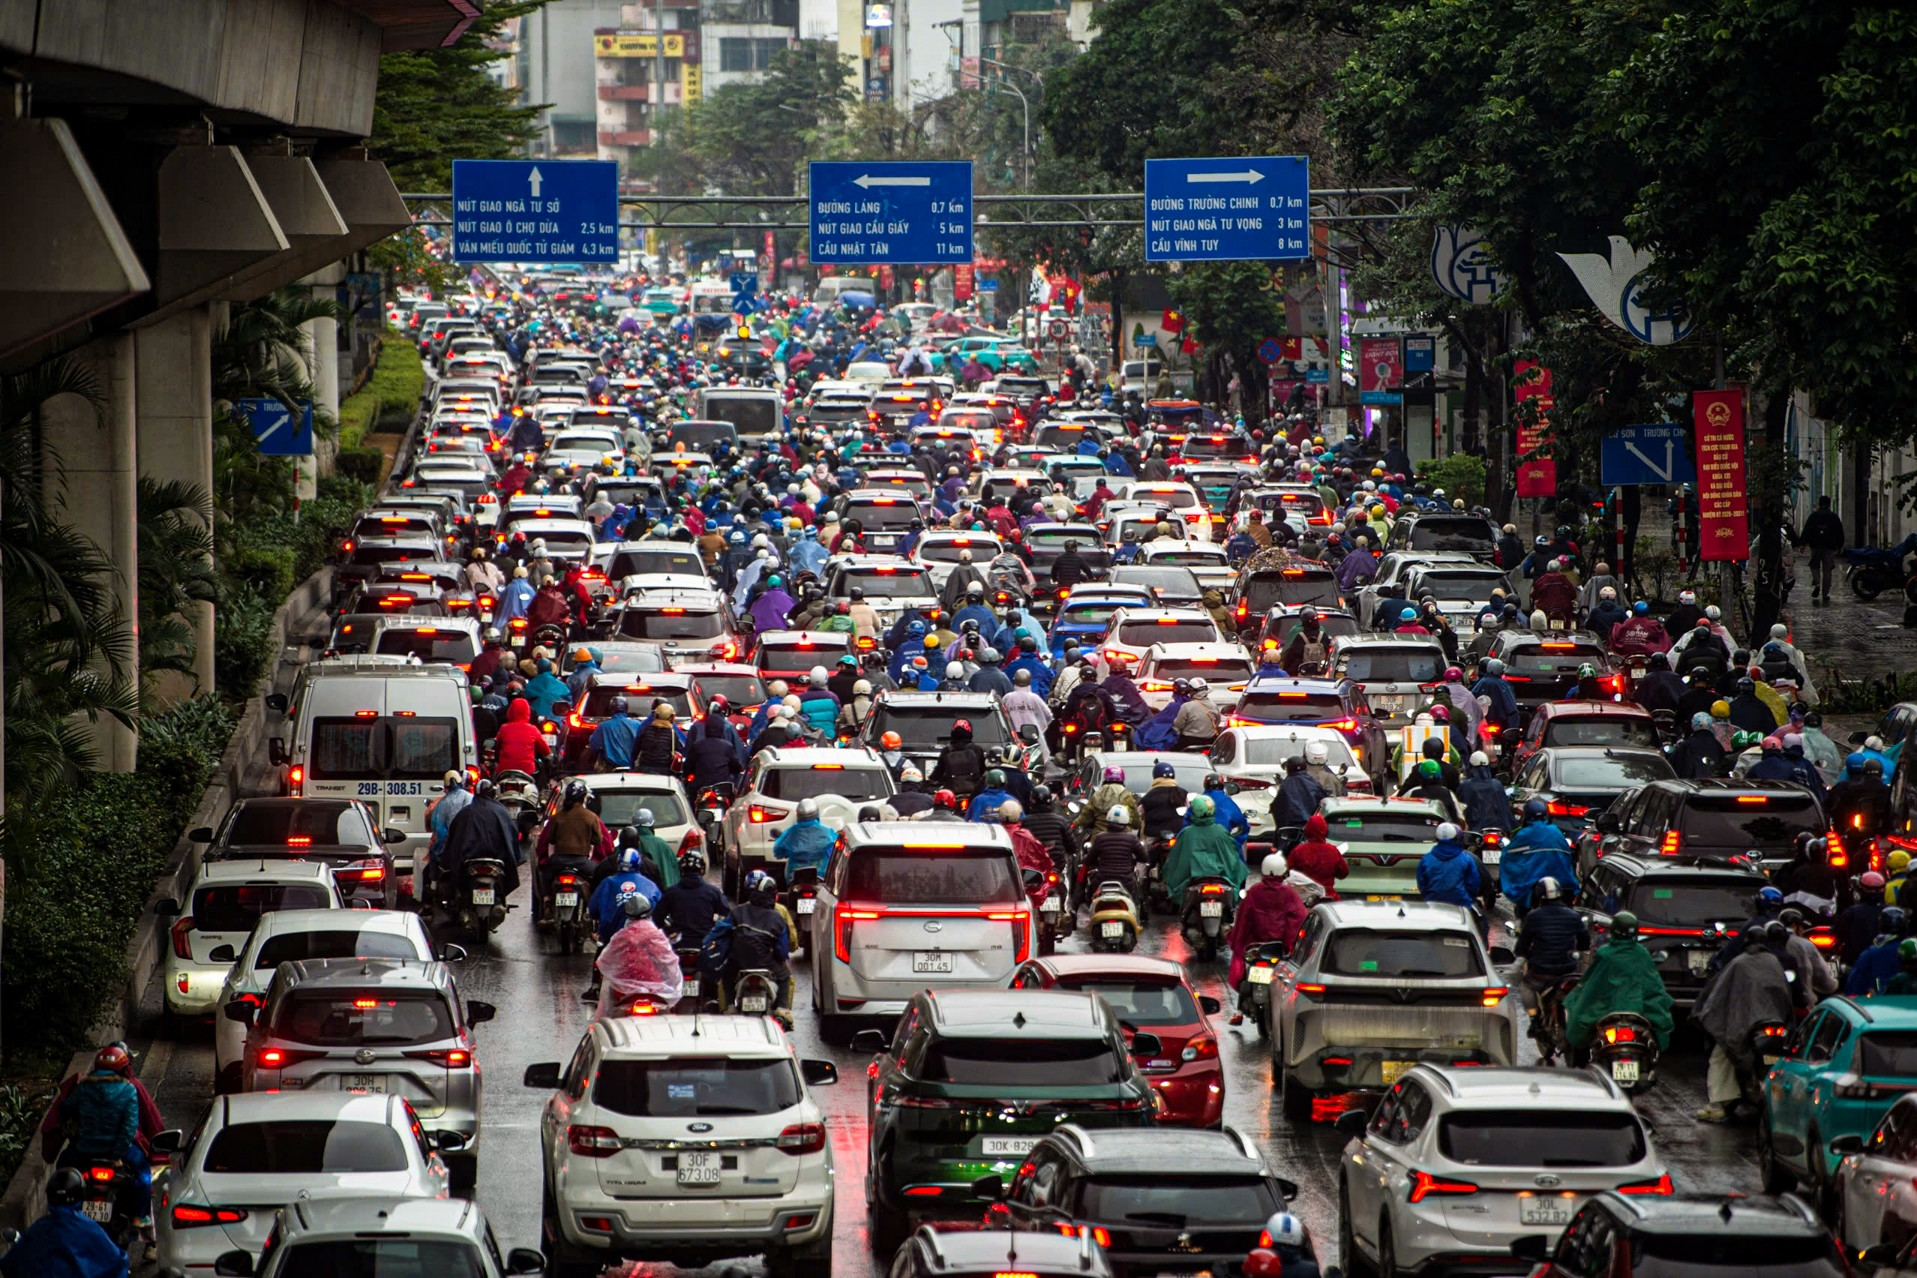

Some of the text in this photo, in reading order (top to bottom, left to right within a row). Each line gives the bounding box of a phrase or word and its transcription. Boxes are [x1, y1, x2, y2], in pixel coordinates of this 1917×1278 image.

[458, 197, 559, 213] NÚT GIAO NGÃ TƯ SỞ
[818, 199, 880, 213] ĐƯỜNG LÁNG
[931, 202, 963, 213] 0.7 km
[1151, 194, 1258, 210] ĐƯỜNG TRƯỜNG CHINH
[1270, 197, 1302, 208] 0.7 km
[458, 218, 559, 235] NÚT GIAO Ô CHỢ DỪA
[599, 223, 613, 234] km
[818, 219, 909, 234] NÚT GIAO CẦU GIẤY
[940, 223, 964, 234] 5 km
[1152, 217, 1262, 232] NÚT GIAO NGÃ TƯ VỌNG
[1278, 218, 1302, 228] 3 km
[459, 239, 574, 254] VĂN MIẾU QUỐC TỬ GIÁM
[599, 244, 613, 254] km
[819, 240, 888, 256] CẦU NHẬT TÂN
[937, 243, 964, 254] 11 km
[1152, 237, 1218, 252] CẦU VĨNH TUY
[1278, 238, 1302, 249] 8 km
[387, 783, 422, 795] 308.51
[925, 953, 941, 962] 30M
[917, 963, 948, 971] 001.45
[354, 1076, 374, 1086] 30H
[687, 1153, 710, 1167] 30F
[678, 1168, 719, 1181] 673.08
[1536, 1199, 1558, 1210] 30L
